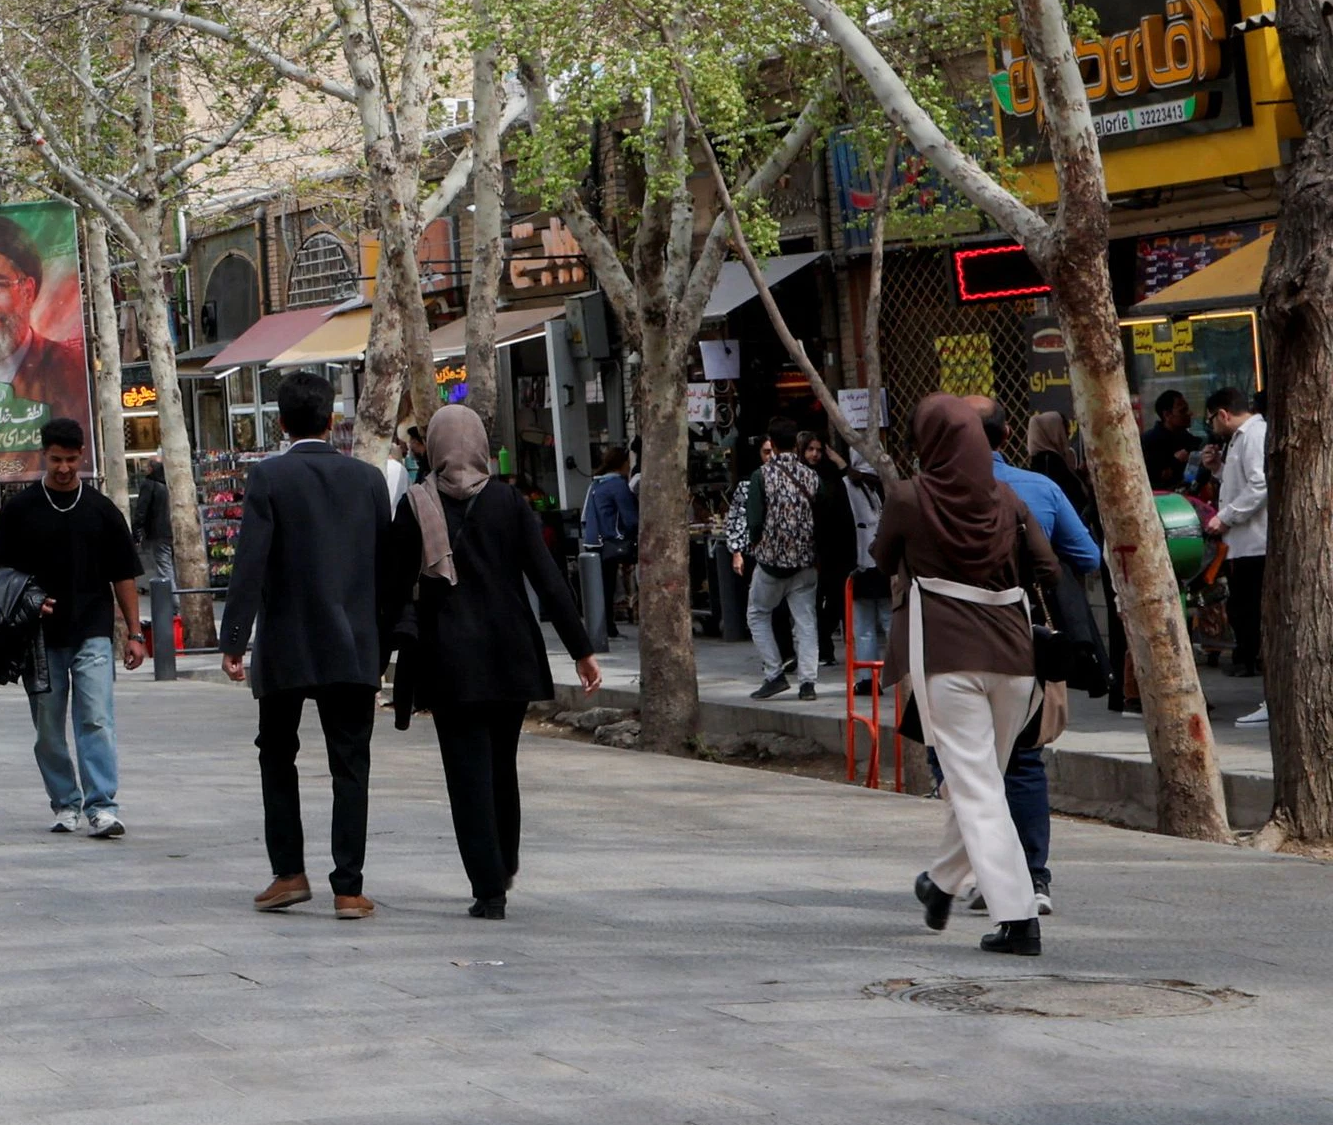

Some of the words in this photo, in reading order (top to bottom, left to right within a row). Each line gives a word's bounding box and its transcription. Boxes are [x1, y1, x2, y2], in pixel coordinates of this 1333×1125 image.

[1139, 104, 1183, 126] 32223413
[1094, 115, 1129, 138] alorie
[10, 403, 44, 424] لطف
